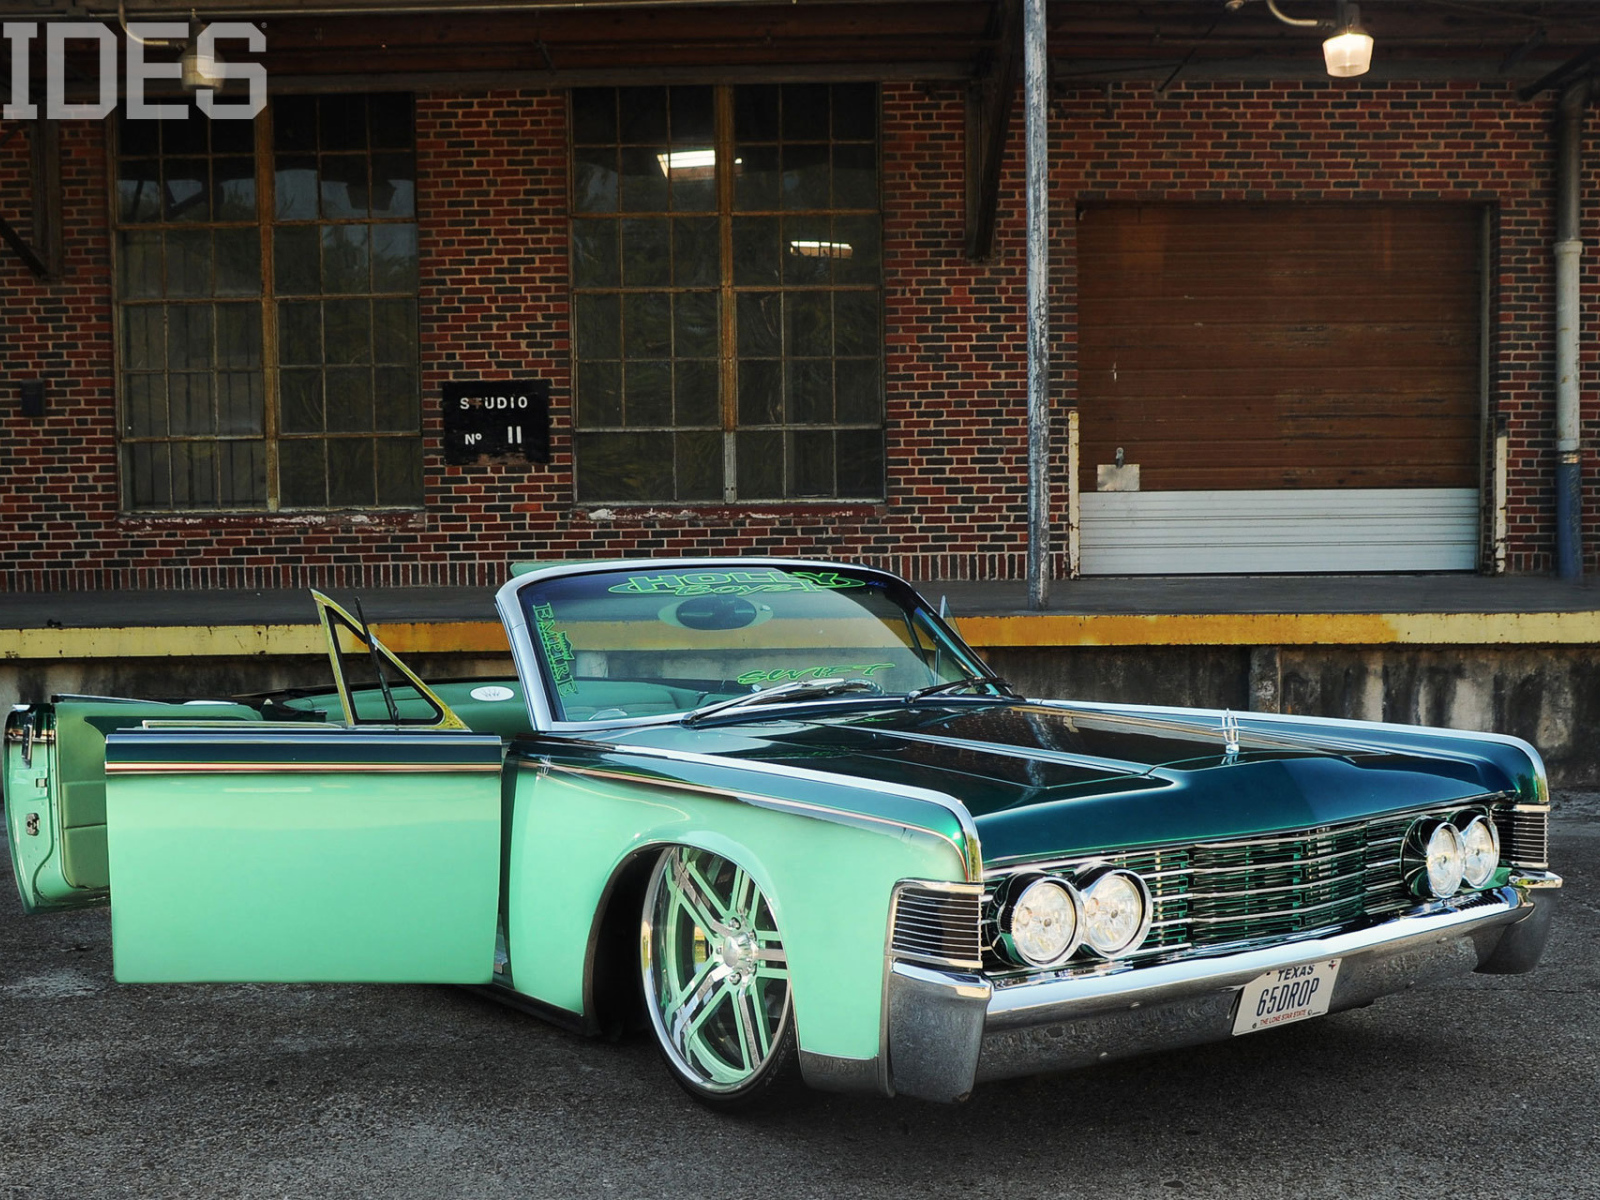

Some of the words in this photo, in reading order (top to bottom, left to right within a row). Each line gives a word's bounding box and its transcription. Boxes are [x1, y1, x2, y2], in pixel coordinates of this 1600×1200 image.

[532, 602, 579, 697] EMPIRE
[1277, 964, 1315, 982] TEXAS
[1256, 977, 1320, 1017] 65DROP
